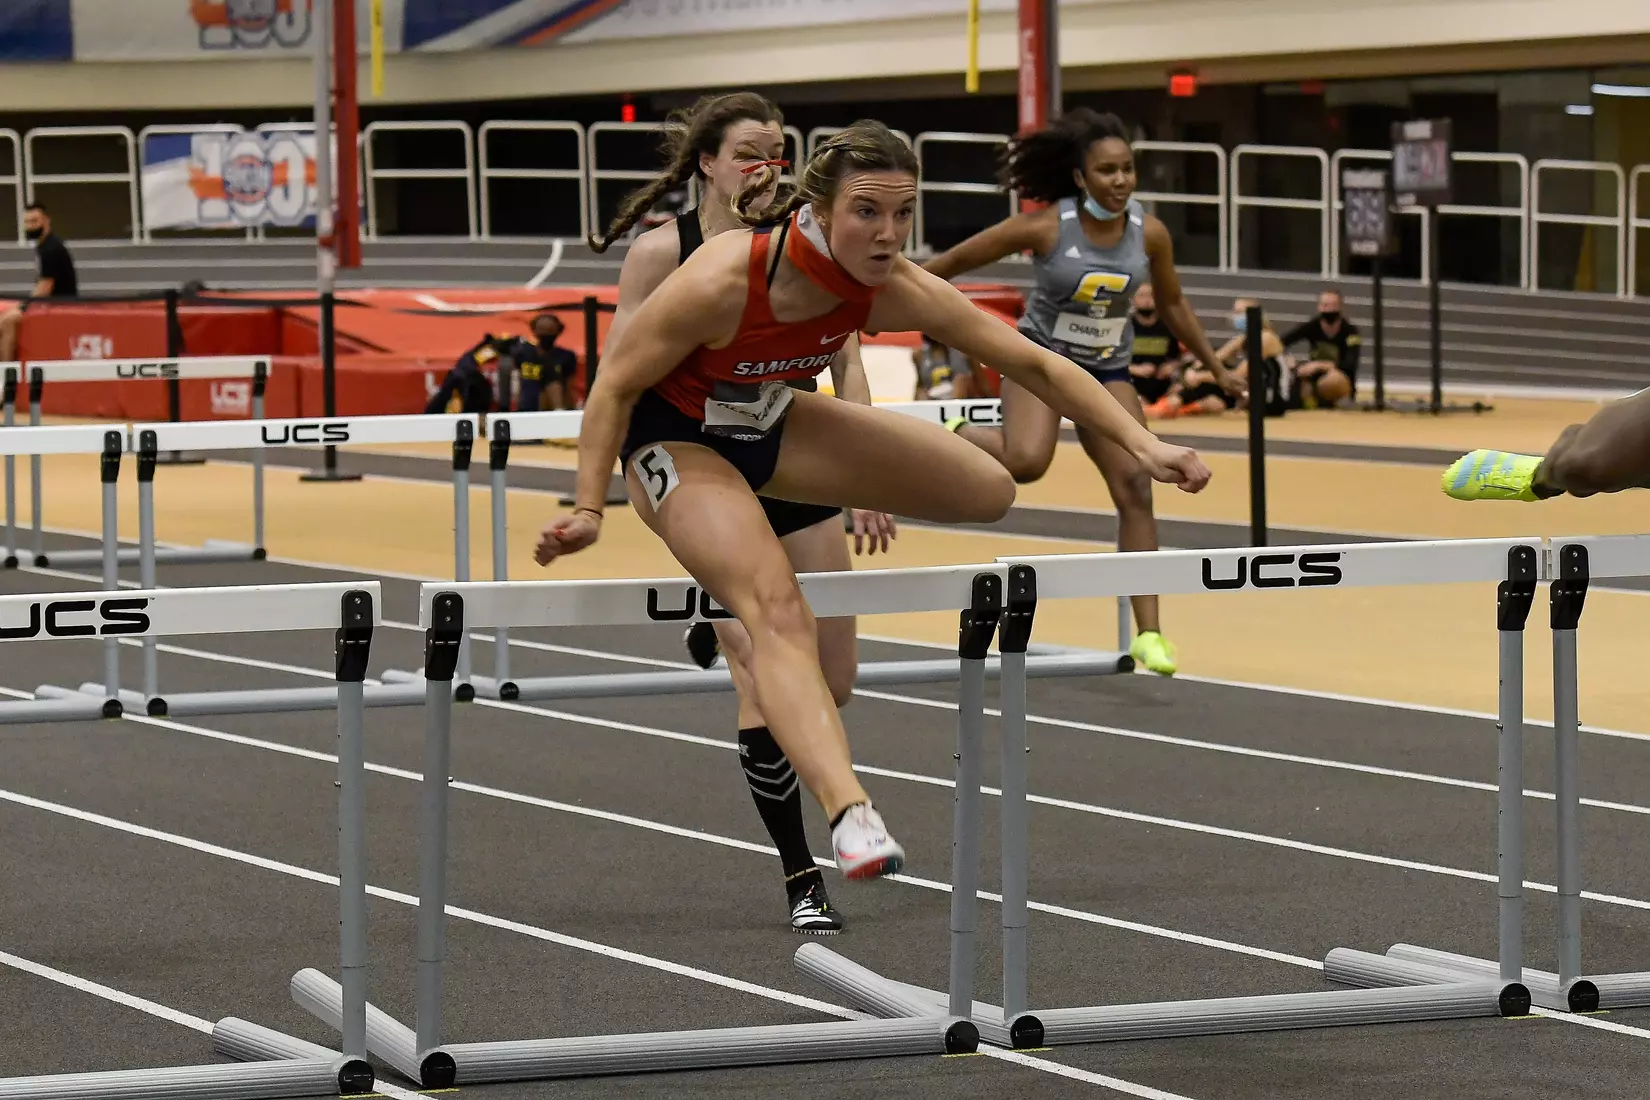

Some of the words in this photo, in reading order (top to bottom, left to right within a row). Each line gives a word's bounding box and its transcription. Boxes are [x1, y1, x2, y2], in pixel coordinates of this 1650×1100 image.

[117, 362, 180, 379] UCS
[733, 352, 838, 376] SAMFOR
[940, 405, 1003, 424] UC
[261, 423, 350, 444] UCS
[640, 449, 668, 502] 5
[1202, 552, 1342, 590] UCS
[647, 586, 736, 621] UC
